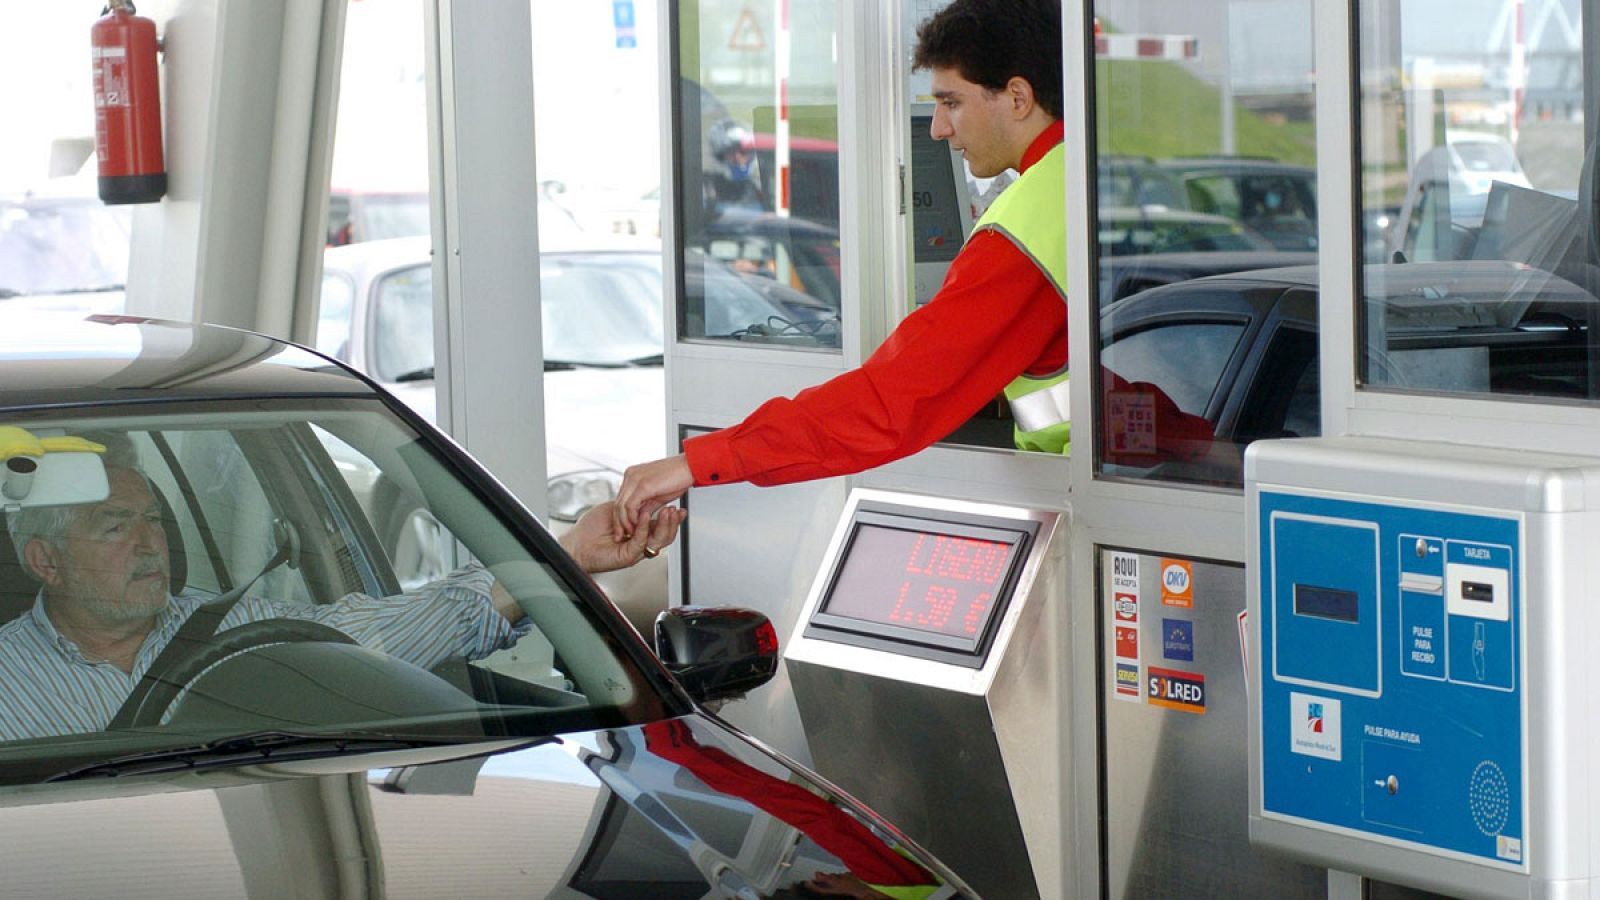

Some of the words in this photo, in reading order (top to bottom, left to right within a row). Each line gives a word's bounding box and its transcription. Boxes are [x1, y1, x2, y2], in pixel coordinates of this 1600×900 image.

[906, 533, 1008, 584] LIGERO
[1463, 547, 1491, 559] TARJETA
[1114, 556, 1137, 577] AQUI
[1166, 571, 1187, 587] DKV
[963, 592, 991, 634] €
[1412, 626, 1433, 638] PULSE
[1414, 639, 1431, 650] PARA
[1411, 651, 1435, 664] RECIBO
[1150, 677, 1202, 702] SOLRED
[1364, 724, 1384, 737] PULSE
[1384, 727, 1400, 740] PARA
[1400, 731, 1421, 744] AYUDA
